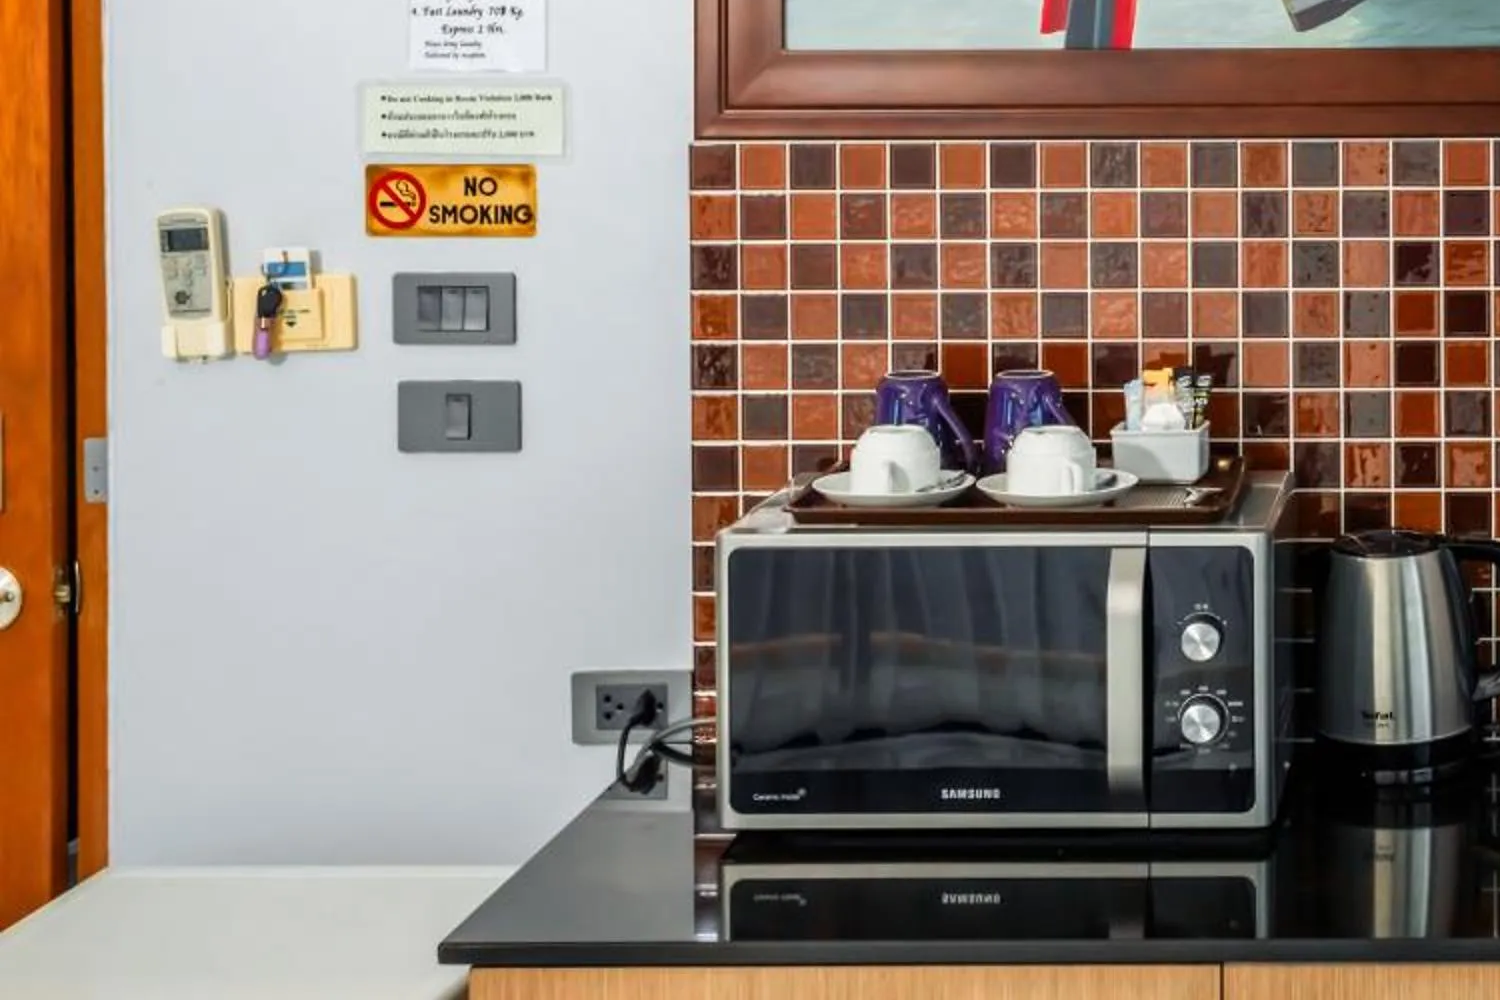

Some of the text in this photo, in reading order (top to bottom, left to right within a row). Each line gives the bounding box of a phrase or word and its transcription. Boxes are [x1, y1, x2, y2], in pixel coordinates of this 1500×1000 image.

[446, 4, 483, 21] Laundry
[464, 176, 497, 197] NO
[429, 205, 533, 225] SMOKING
[941, 788, 1001, 799] SAMSUNG
